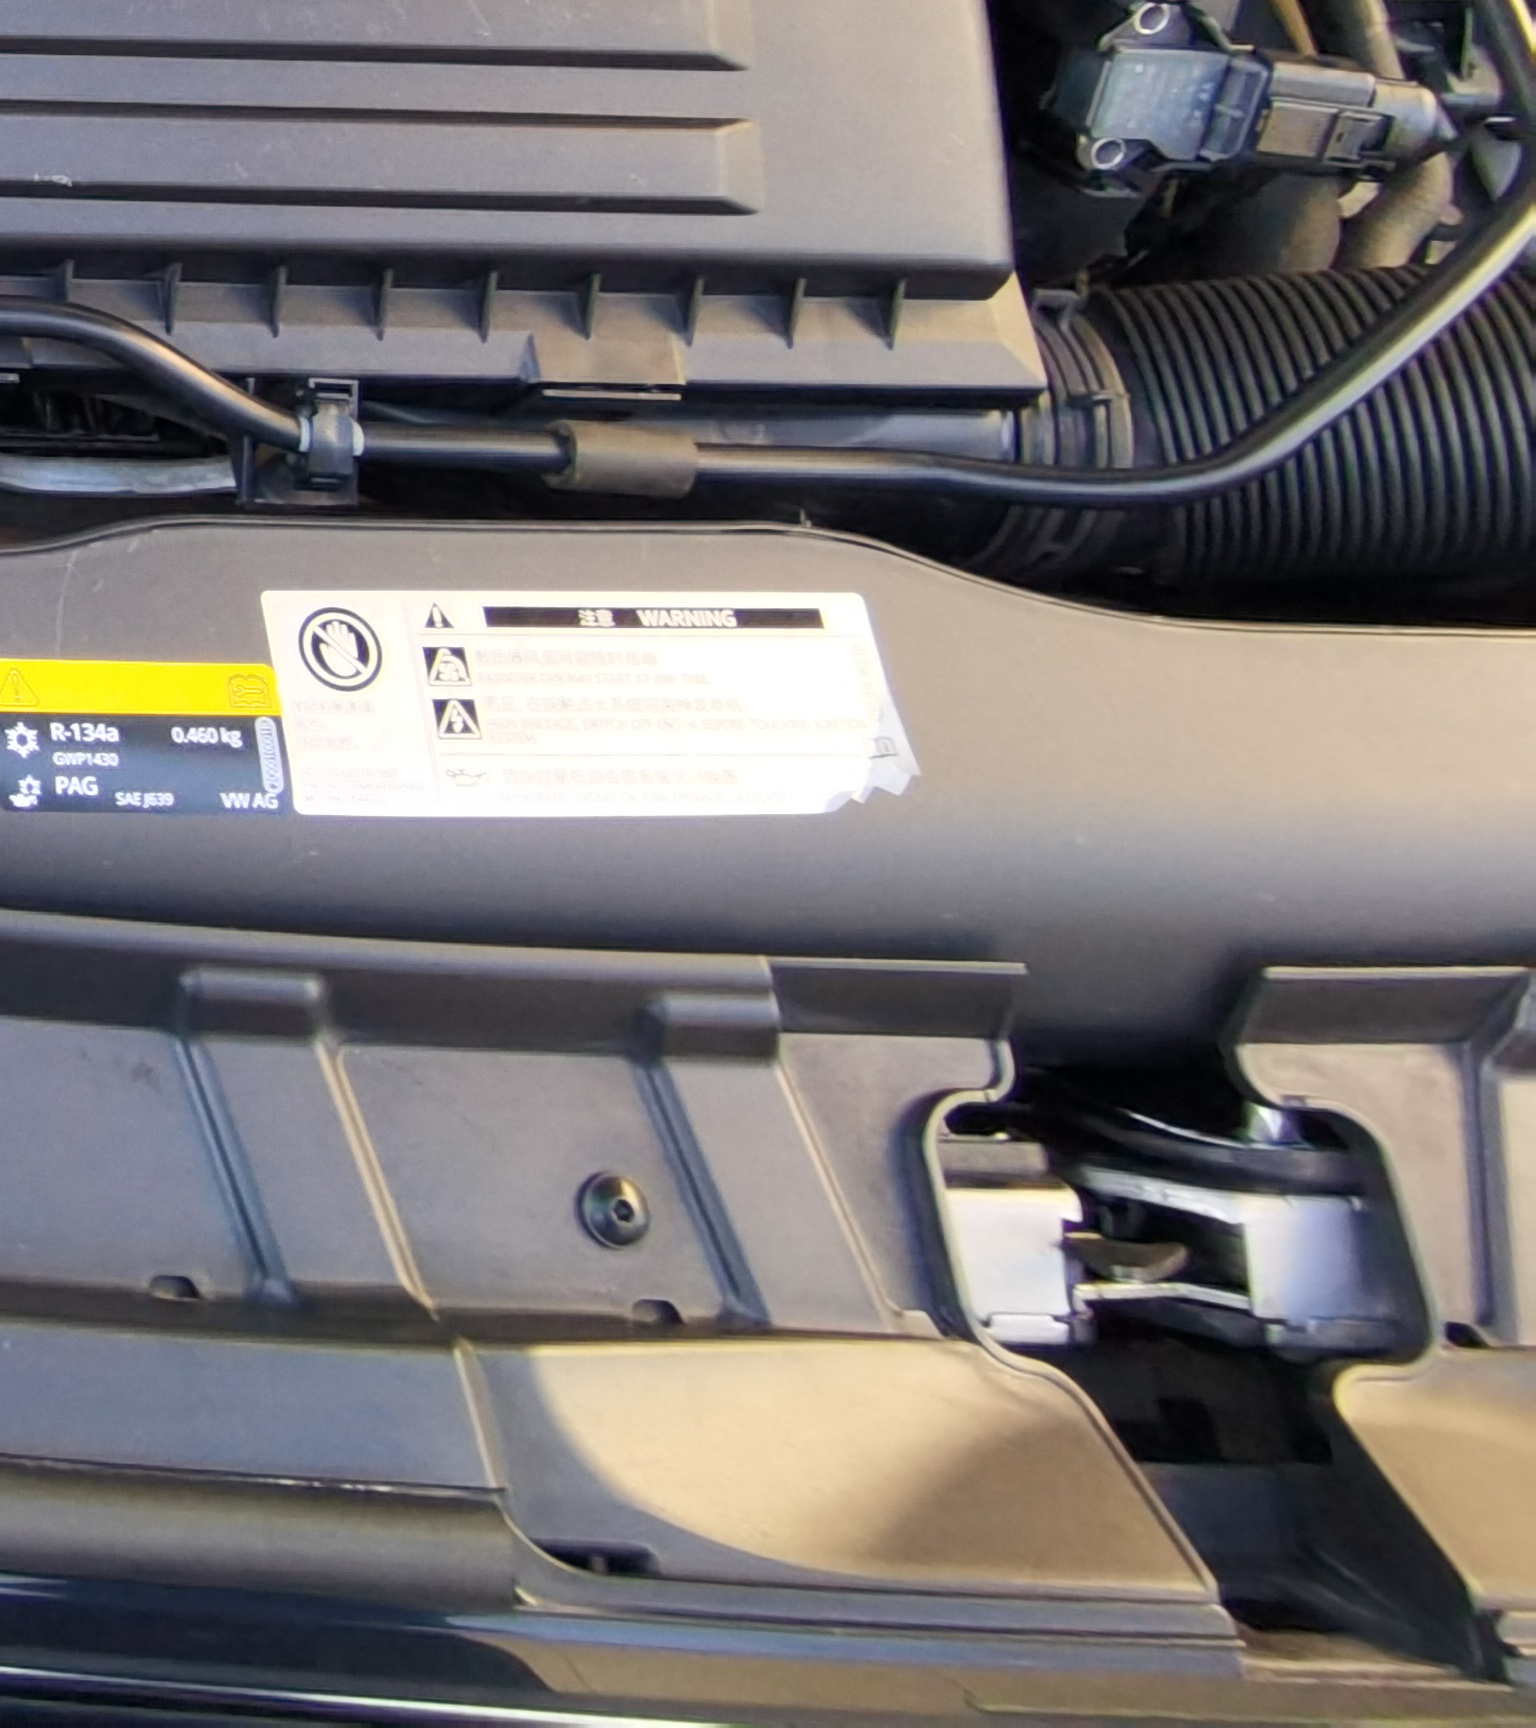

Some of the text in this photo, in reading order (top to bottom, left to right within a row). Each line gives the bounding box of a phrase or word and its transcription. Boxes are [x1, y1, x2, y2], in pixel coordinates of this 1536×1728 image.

[635, 609, 738, 628] WARNING
[49, 721, 243, 749] R-134a 0.460 kg
[52, 750, 120, 768] GWP1430
[54, 776, 99, 796] PAG
[115, 791, 141, 808] SAE
[219, 791, 254, 809] VW
[256, 792, 279, 810] AG
